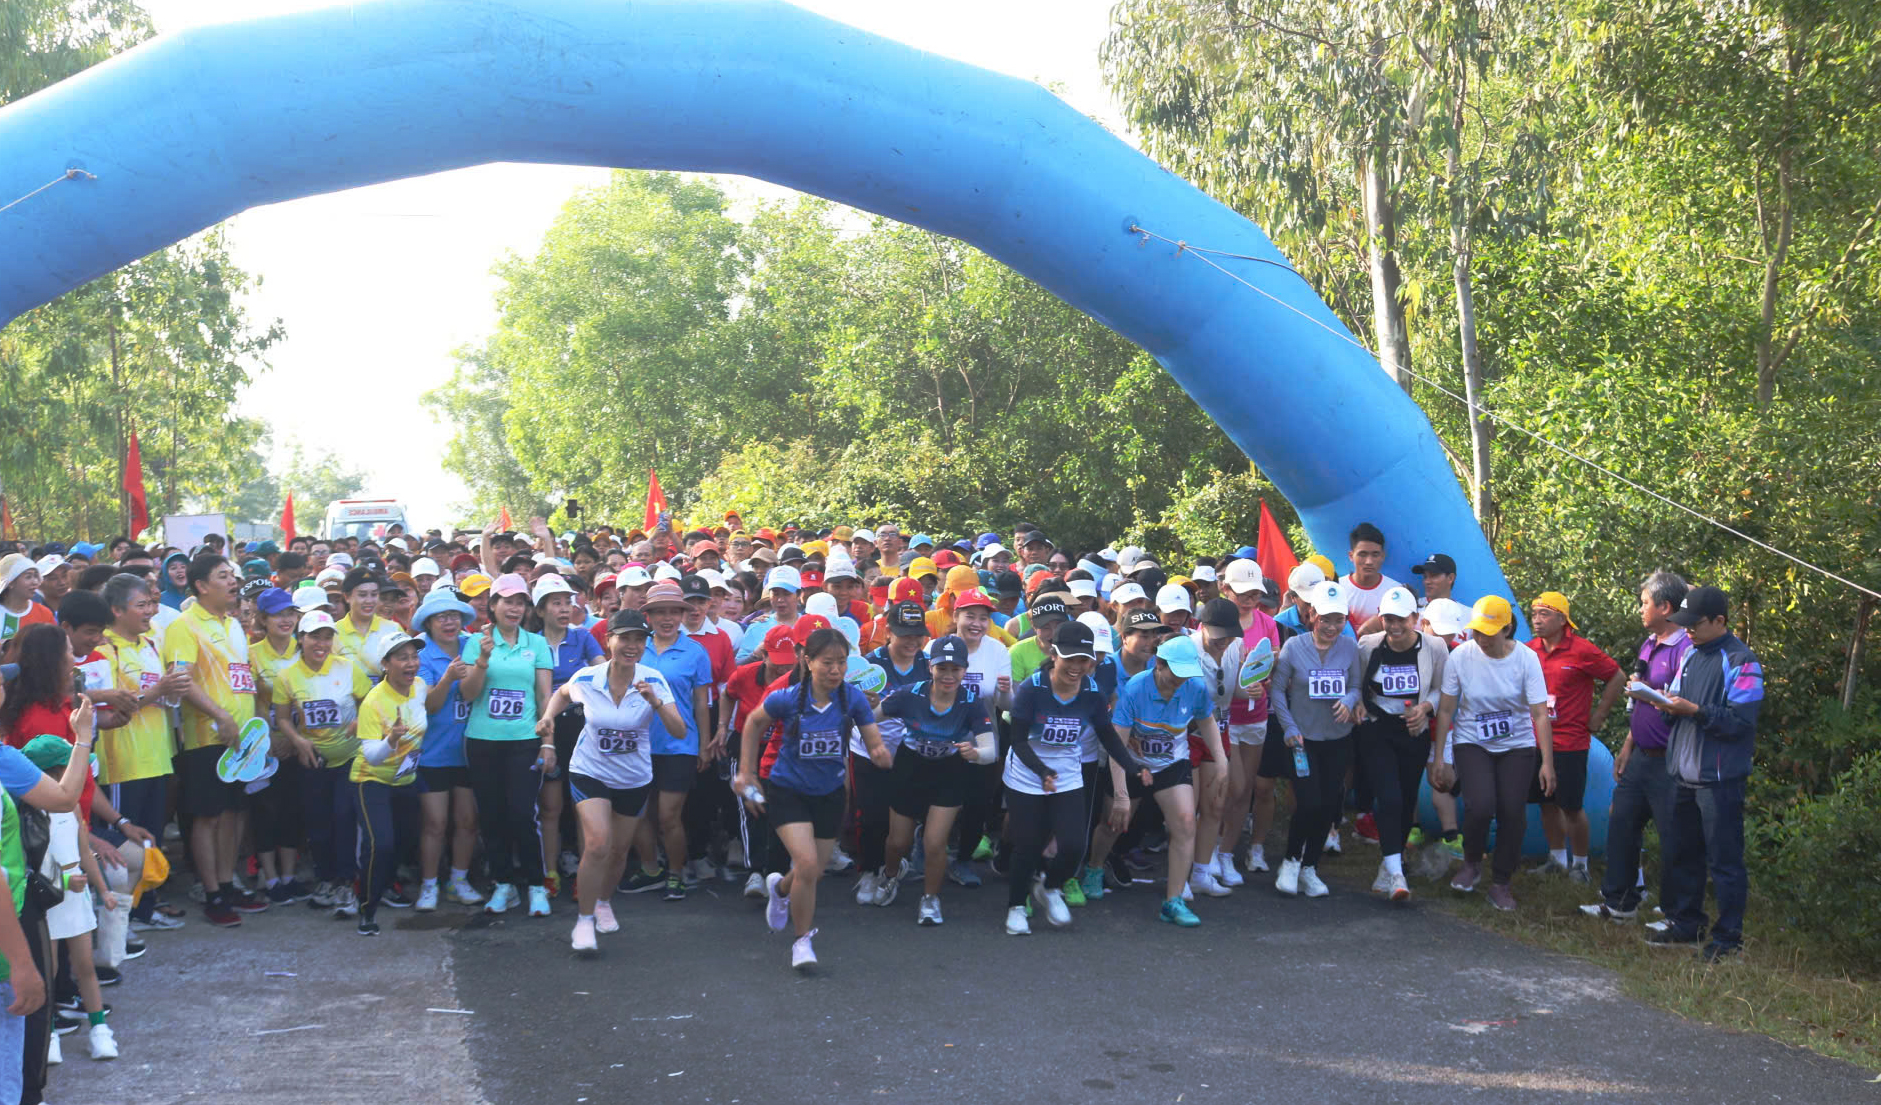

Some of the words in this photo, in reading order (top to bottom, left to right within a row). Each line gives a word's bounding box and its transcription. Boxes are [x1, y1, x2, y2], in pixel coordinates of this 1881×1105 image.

[1032, 603, 1065, 616] SPORT
[1311, 680, 1343, 694] 160
[1383, 675, 1418, 691] 069
[490, 699, 524, 715] 026
[306, 709, 338, 724] 132
[1043, 728, 1078, 742] 095
[1481, 720, 1510, 737] 119
[600, 737, 638, 751] 029
[801, 740, 840, 755] 092
[1141, 740, 1174, 754] 002
